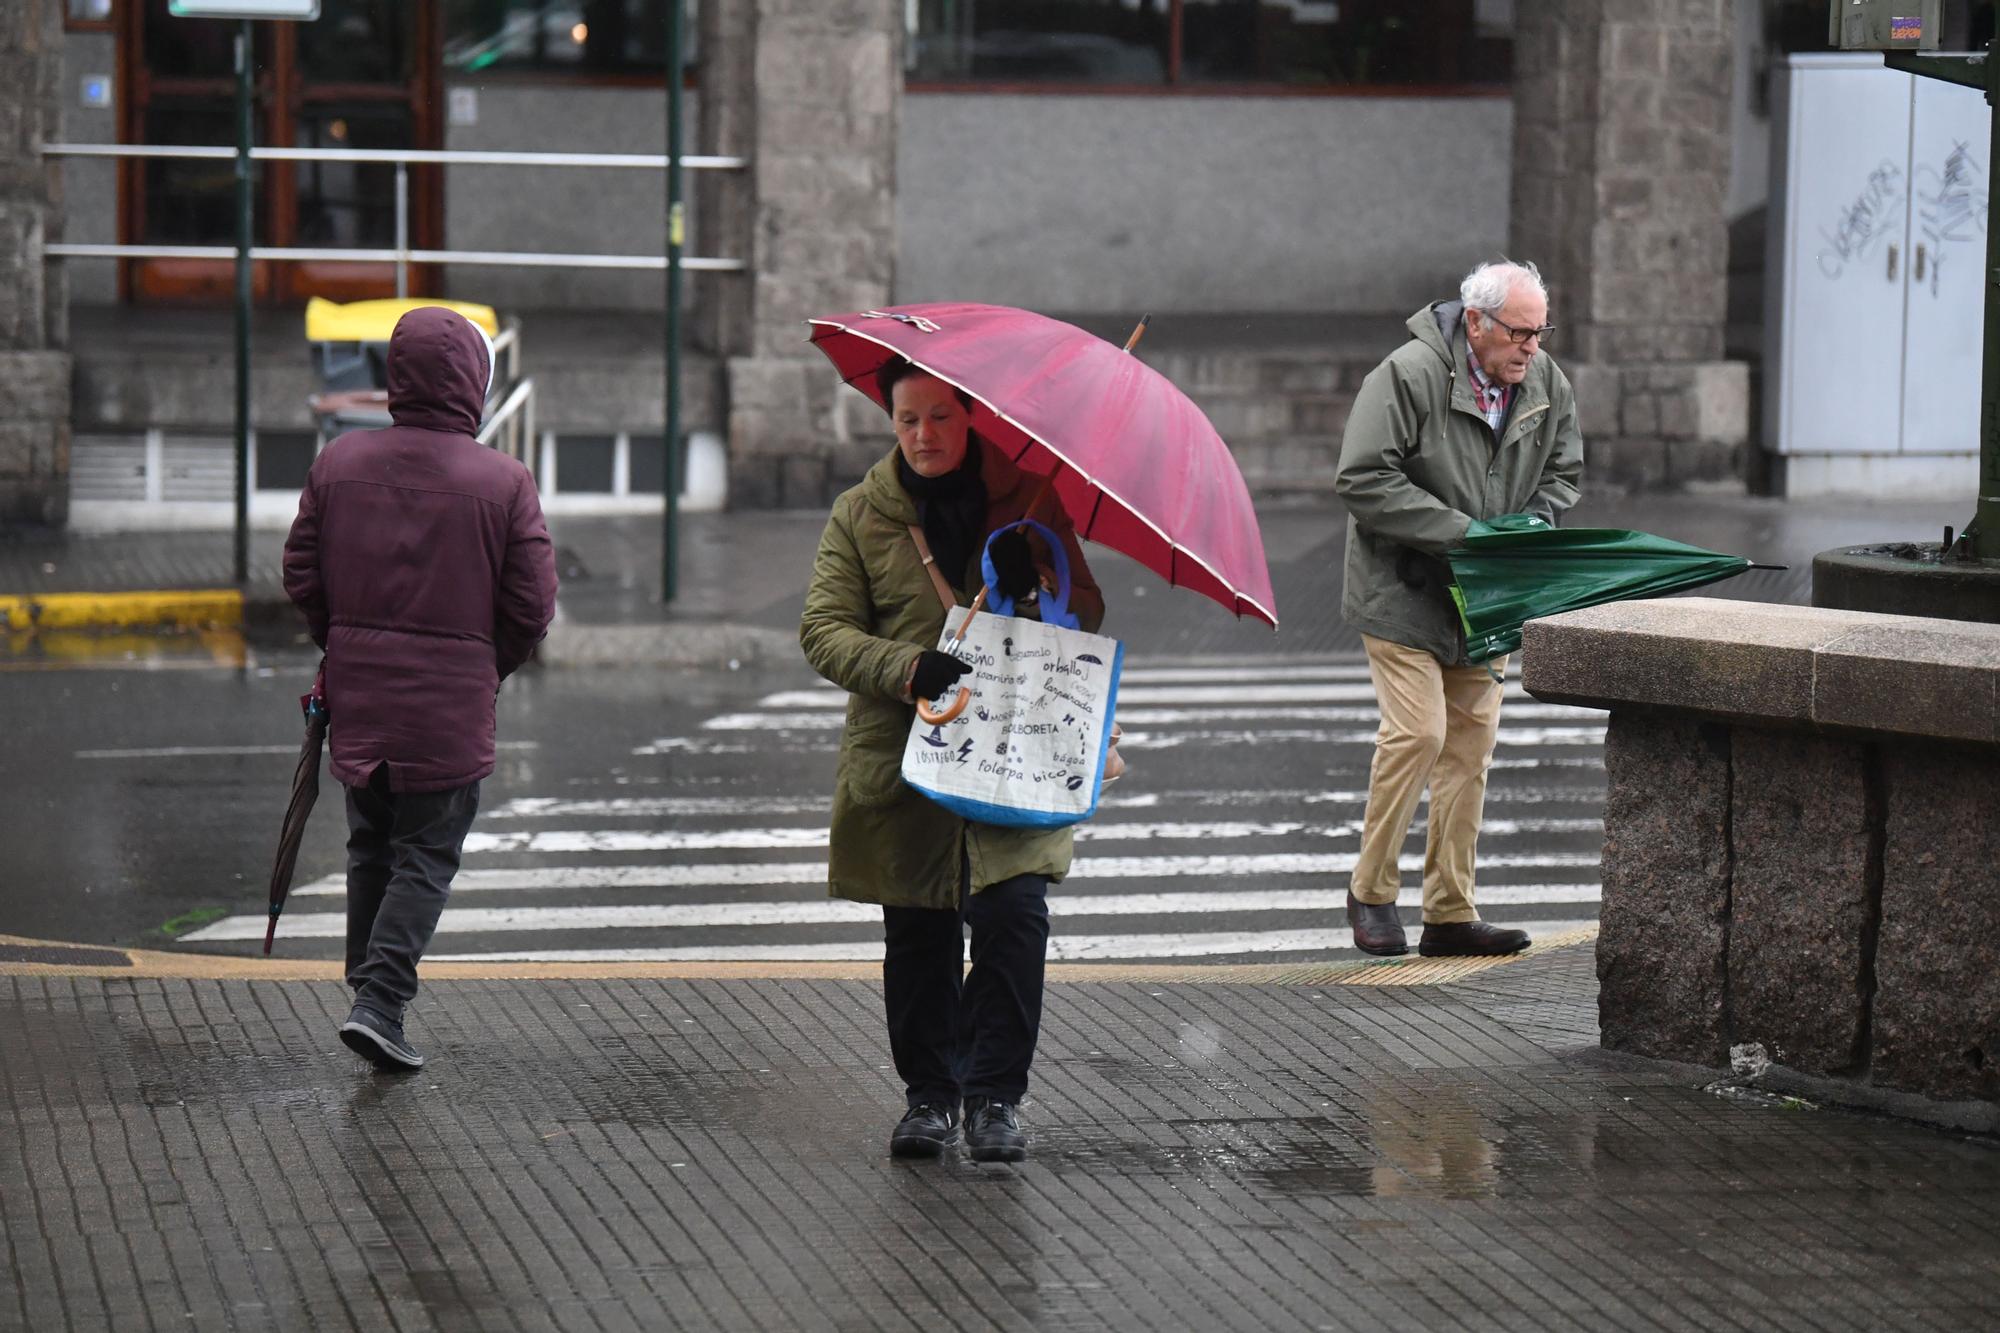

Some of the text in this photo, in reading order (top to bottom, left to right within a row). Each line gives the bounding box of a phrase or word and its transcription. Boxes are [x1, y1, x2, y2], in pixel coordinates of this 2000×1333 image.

[1043, 656, 1082, 676] orballo
[1001, 724, 1060, 735] BOLBORETA
[1052, 752, 1086, 766] bágoa
[978, 760, 1024, 781] folerpa
[1032, 769, 1067, 783] bico
